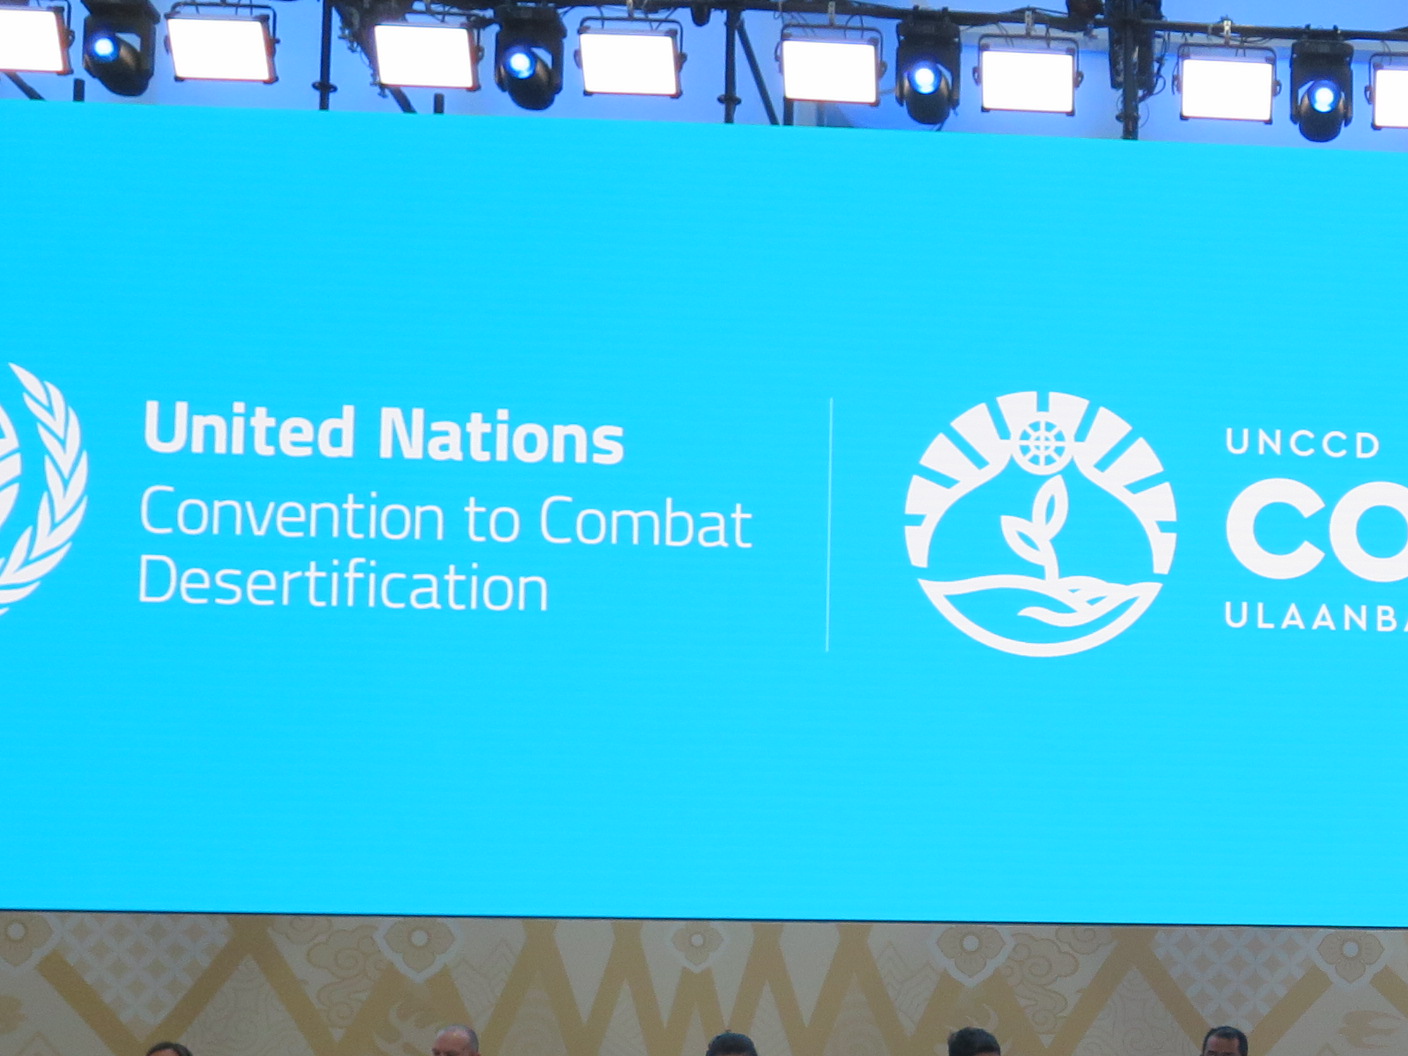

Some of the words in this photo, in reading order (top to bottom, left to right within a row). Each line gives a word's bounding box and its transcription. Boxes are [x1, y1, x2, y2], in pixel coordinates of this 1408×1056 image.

[145, 401, 354, 457] United
[380, 407, 624, 464] Nations
[1227, 428, 1380, 458] UNCCD
[142, 485, 443, 540] Convention
[464, 497, 519, 542] to
[541, 496, 752, 548] Combat
[140, 555, 547, 610] Desertification
